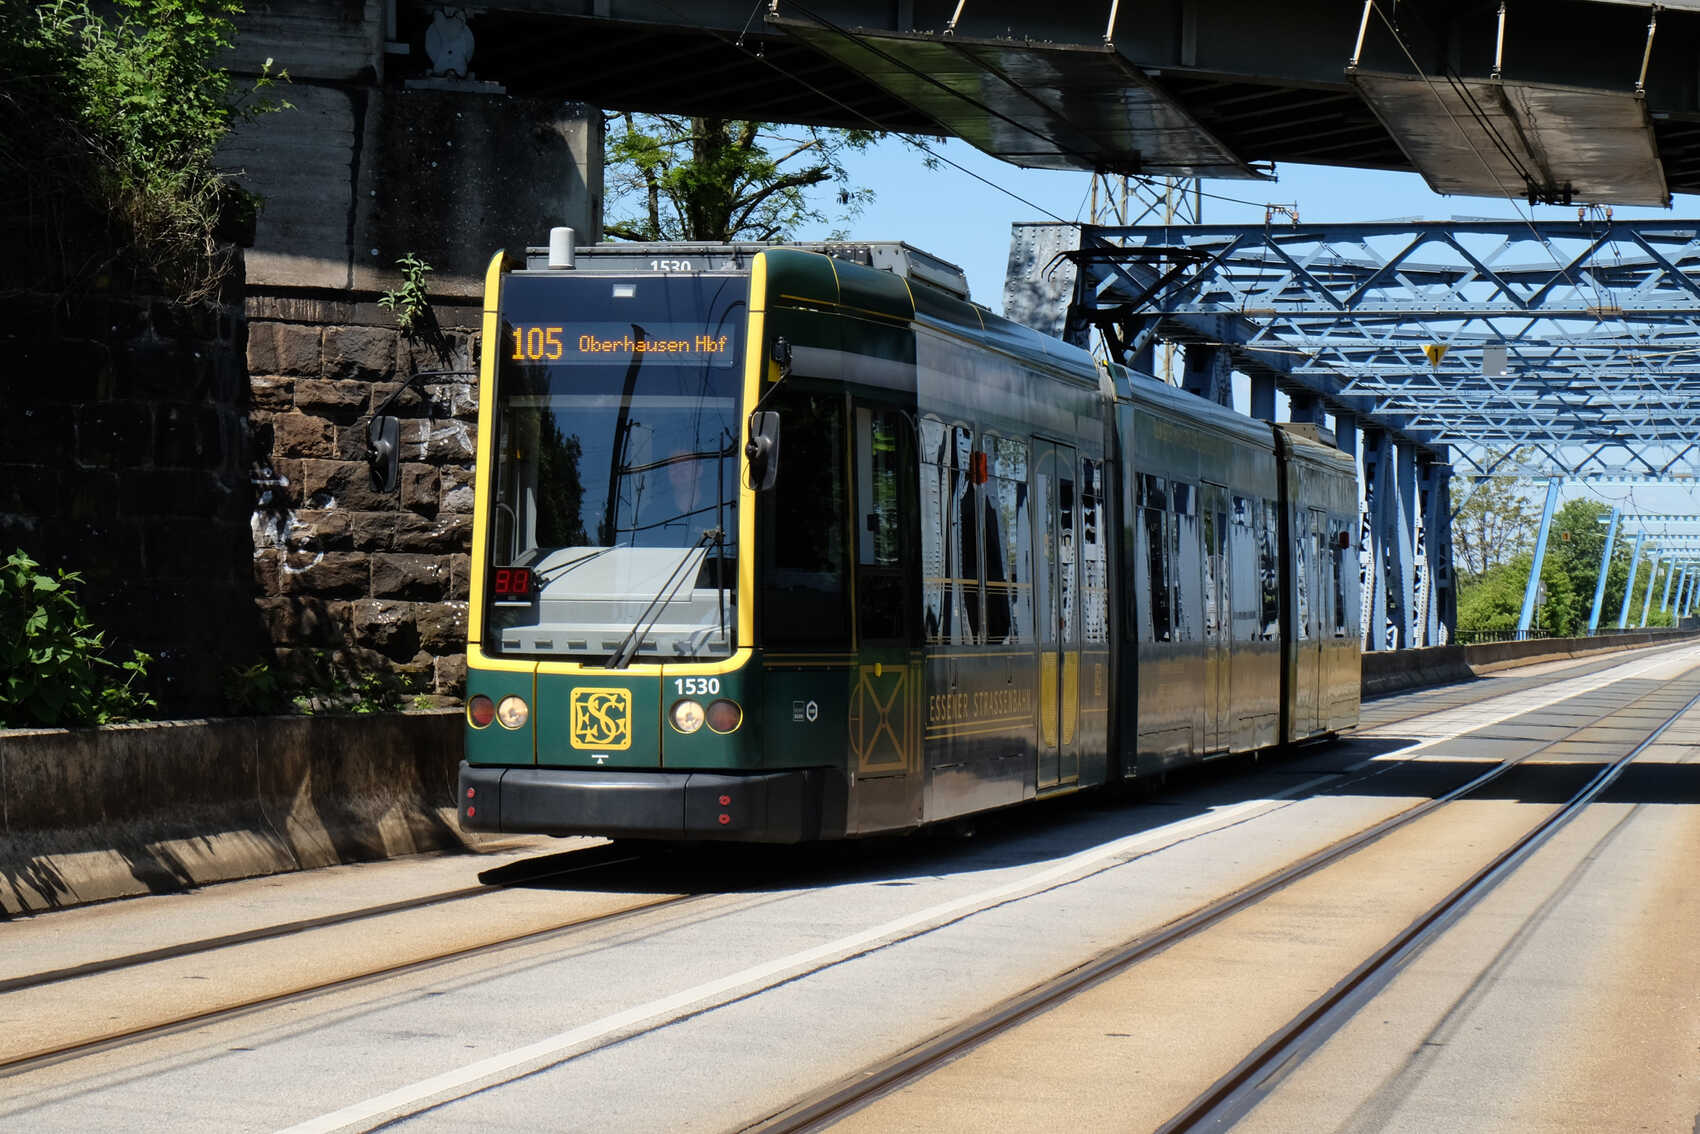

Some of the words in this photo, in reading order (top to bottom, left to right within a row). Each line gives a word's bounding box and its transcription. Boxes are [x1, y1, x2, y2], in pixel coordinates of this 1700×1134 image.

[650, 260, 692, 272] 1530
[511, 326, 563, 360] 105
[578, 334, 690, 353] Oberhausen
[695, 334, 728, 352] Hbf
[674, 678, 720, 695] 1530
[929, 692, 969, 722] ESSENER
